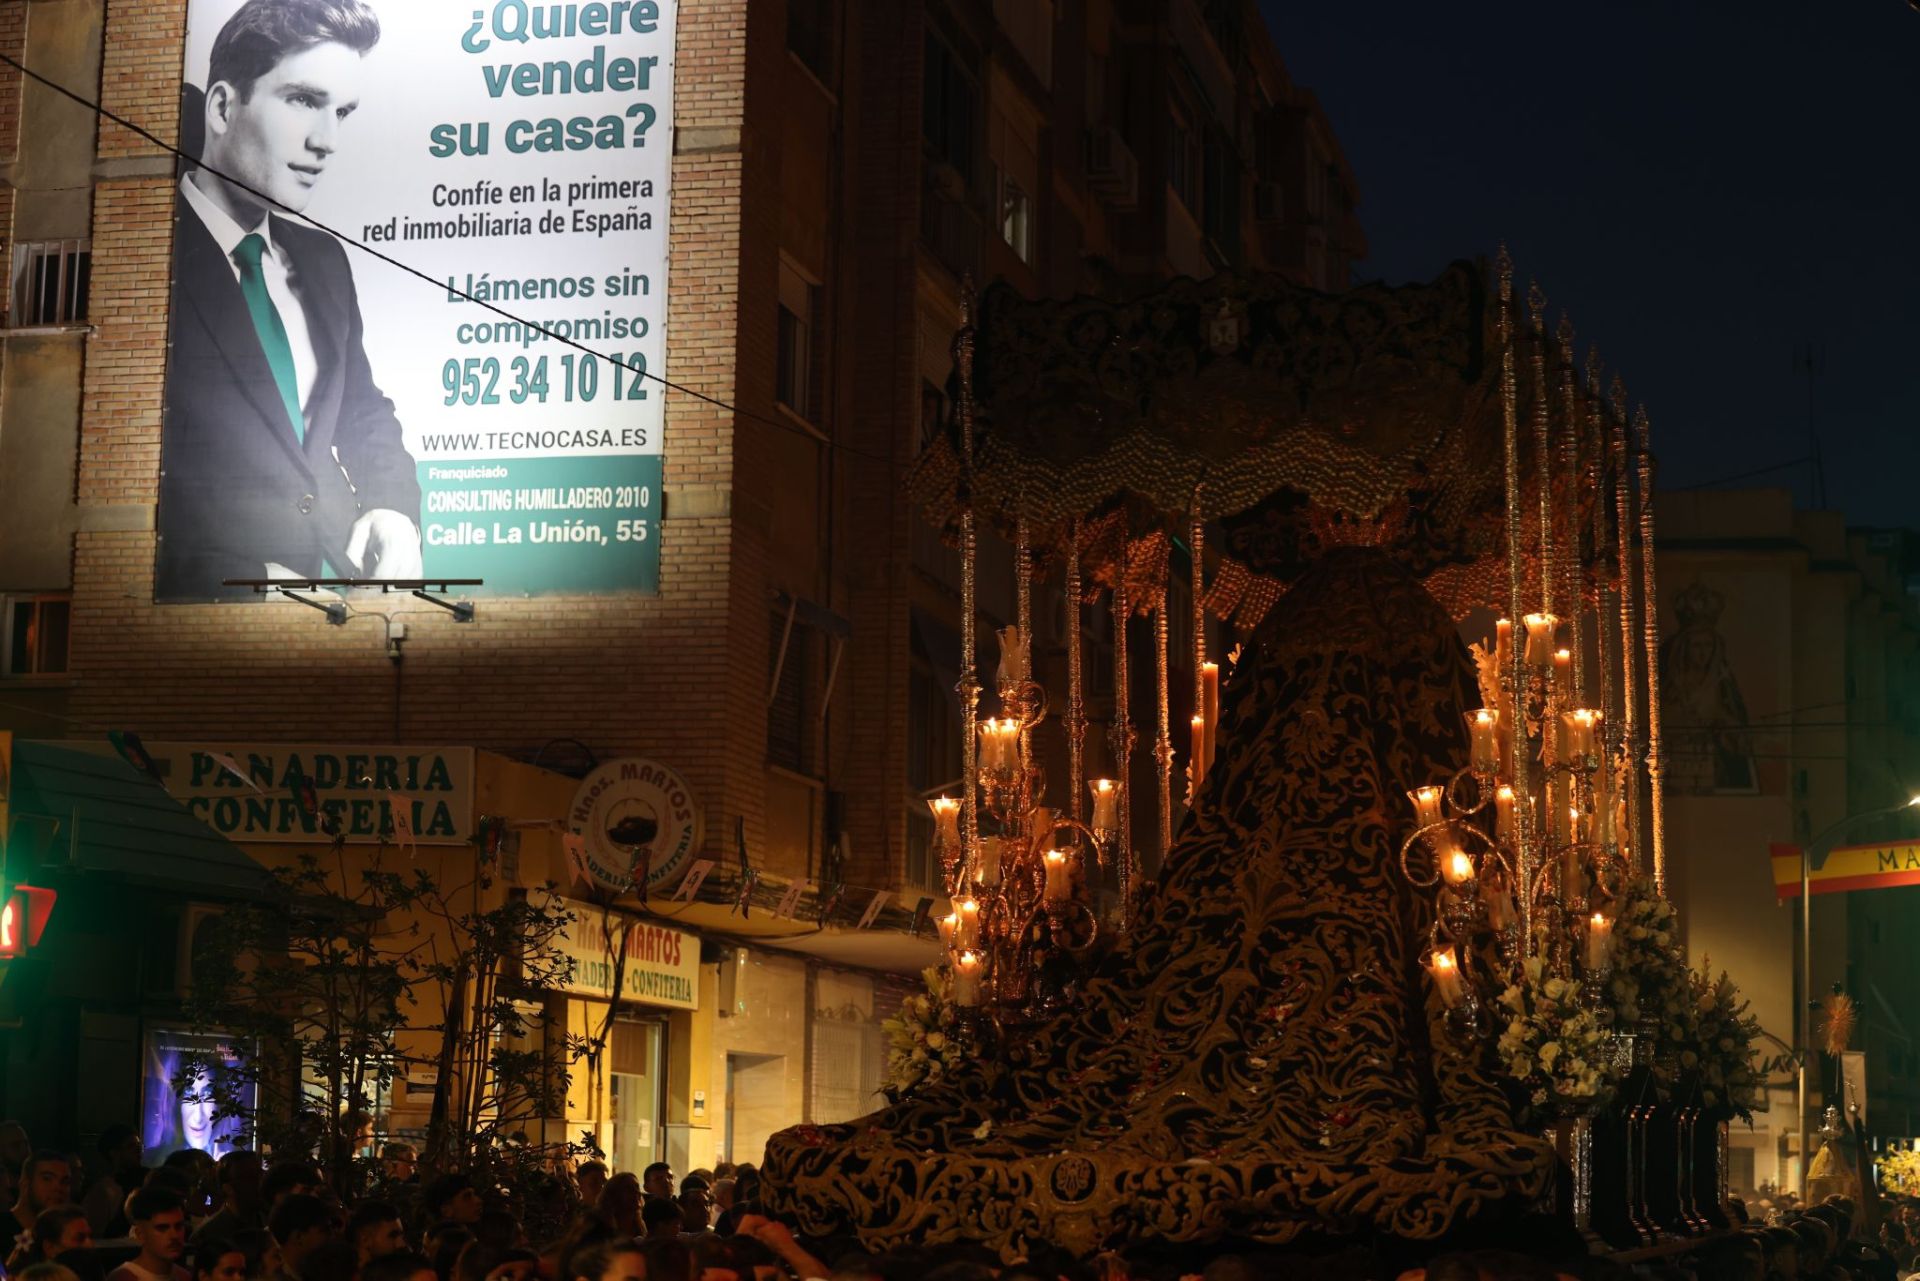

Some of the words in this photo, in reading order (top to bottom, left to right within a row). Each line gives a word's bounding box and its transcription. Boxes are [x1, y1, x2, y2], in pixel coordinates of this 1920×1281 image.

[461, 0, 659, 53] ¿Quiere
[482, 45, 658, 98] vender
[429, 122, 489, 158] su
[505, 103, 657, 155] casa?
[432, 181, 503, 207] Confíe
[509, 186, 536, 204] en
[542, 178, 561, 203] la
[568, 175, 653, 207] primera
[363, 217, 396, 243] red
[403, 209, 532, 240] inmobiliaria
[539, 211, 565, 235] de
[572, 206, 652, 237] España
[448, 273, 595, 303] Llámenos
[604, 268, 650, 297] sin
[457, 311, 649, 348] compromiso
[442, 357, 500, 406] 952
[510, 355, 549, 405] 34
[561, 353, 598, 402] 10
[610, 352, 648, 400] 12
[422, 428, 647, 452] WWW.TECNOCASA.ES
[428, 465, 508, 481] Franquiciado
[427, 490, 511, 513] CONSULTING
[515, 487, 612, 510] HUMILLADERO
[616, 486, 649, 509] 2010
[427, 523, 485, 546] Calle
[493, 522, 521, 545] La
[529, 519, 608, 547] Unión,
[616, 520, 647, 541] 55
[190, 752, 453, 790] PANADERIA
[574, 777, 615, 823] Hnos.
[620, 763, 692, 821] MARTOS
[189, 796, 456, 835] CONFTERIA
[625, 919, 681, 966] MARTOS
[633, 968, 692, 1002] CONFITERIA
